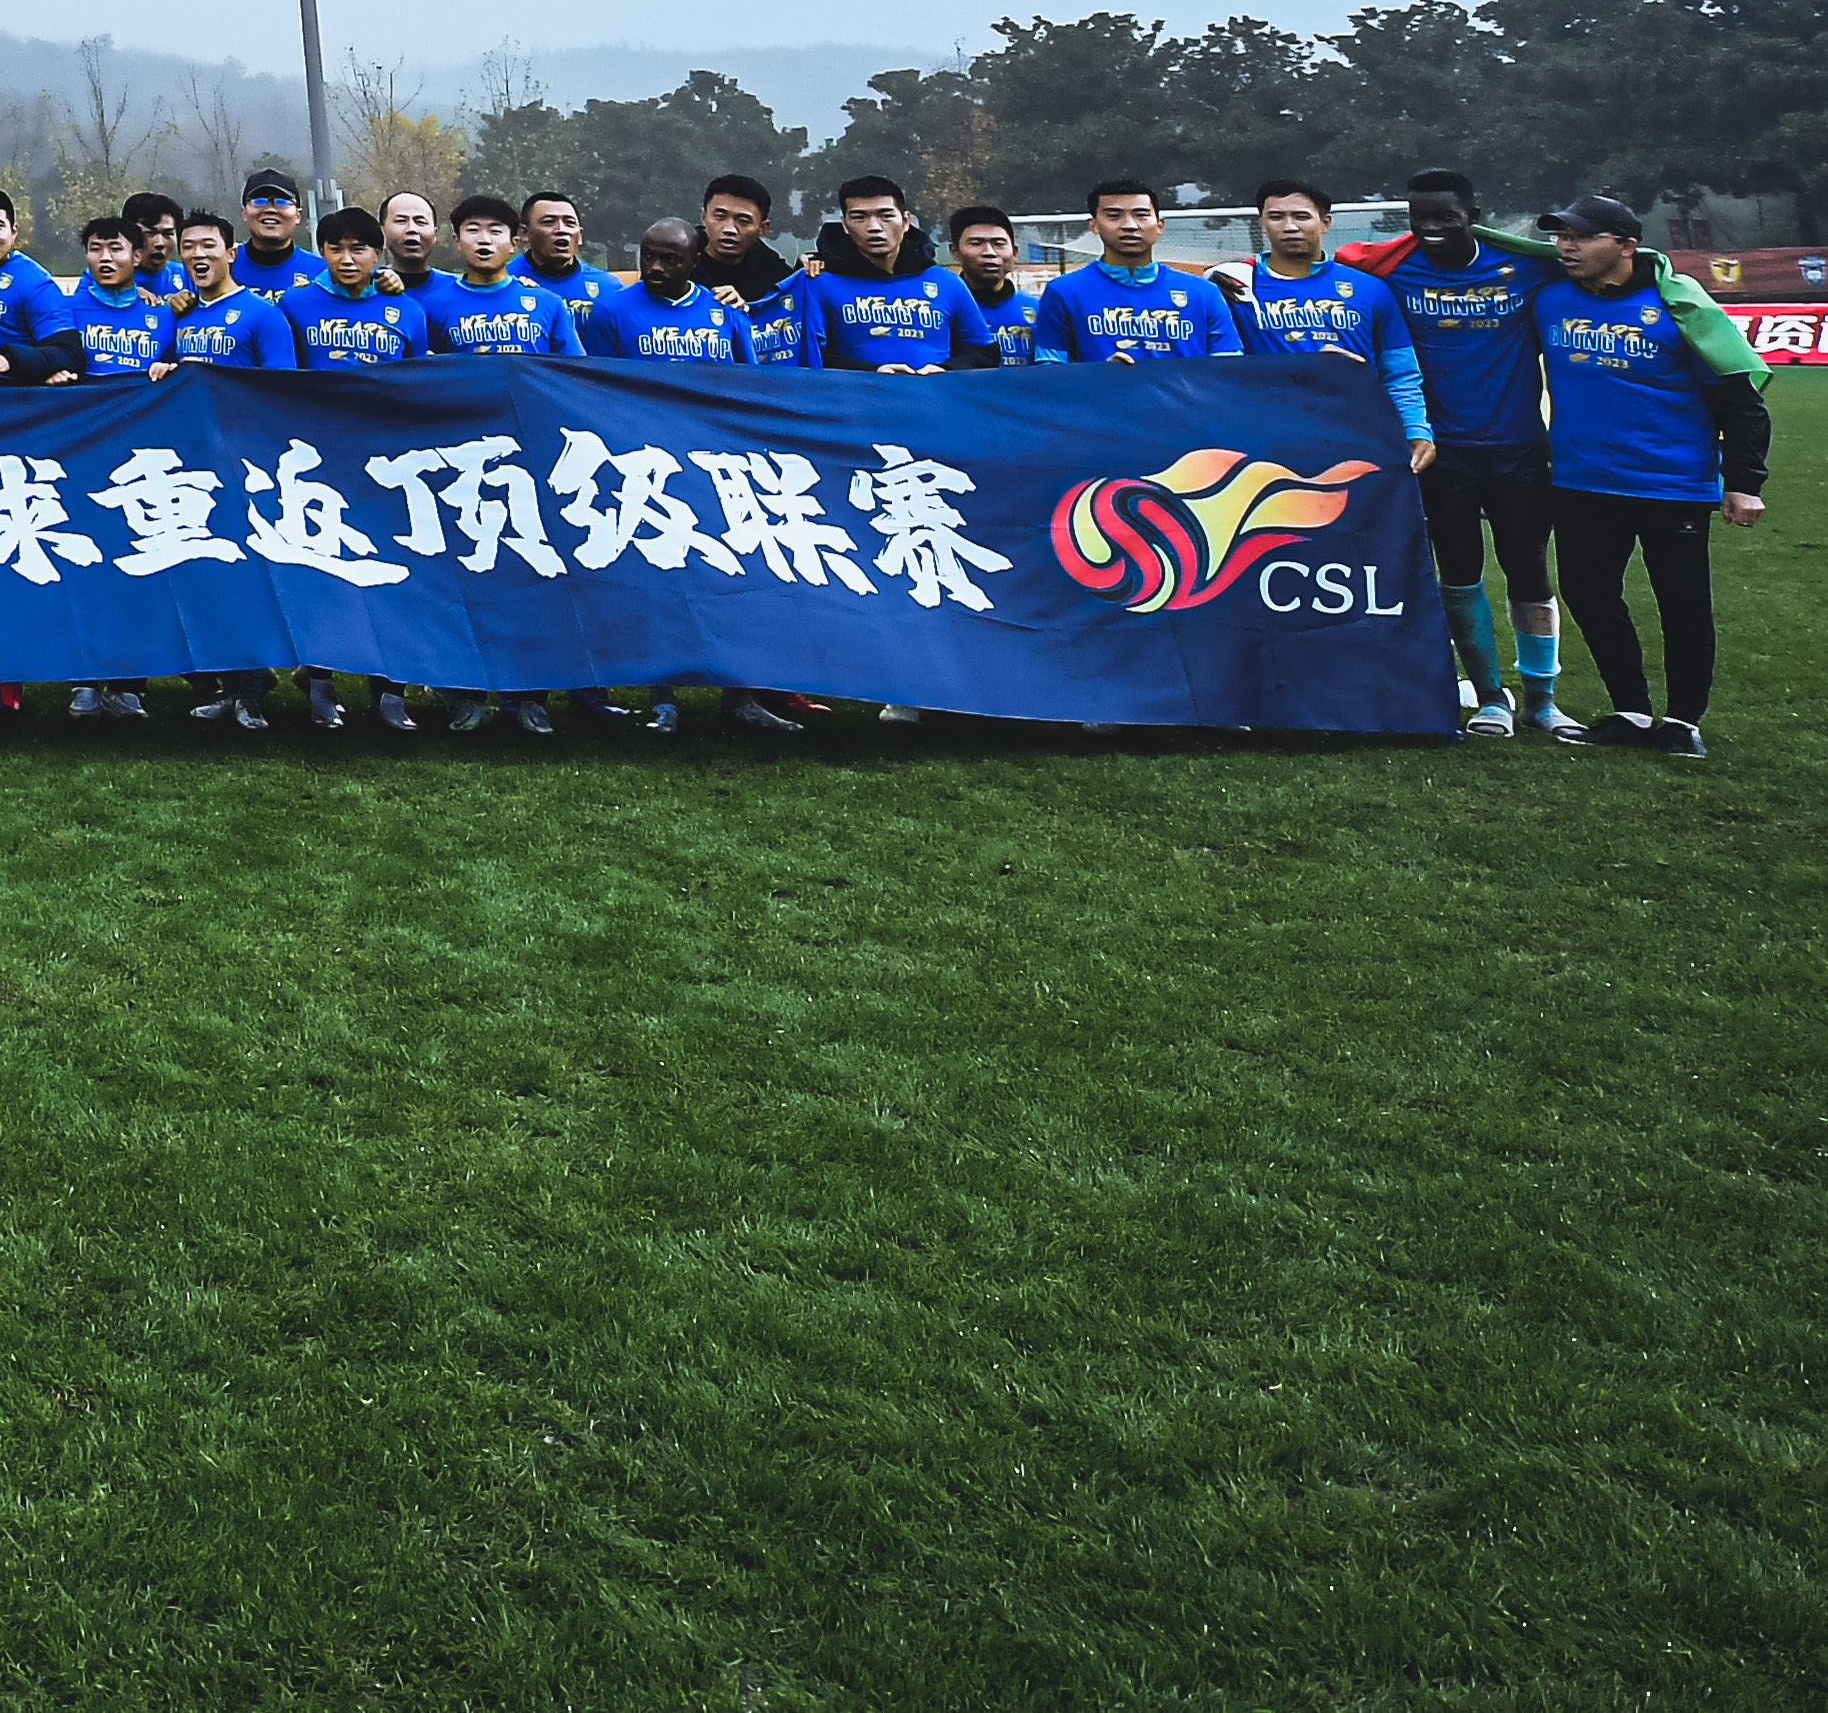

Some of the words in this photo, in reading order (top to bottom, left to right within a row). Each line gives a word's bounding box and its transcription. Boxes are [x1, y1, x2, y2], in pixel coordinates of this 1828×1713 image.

[1424, 288, 1453, 300] WE
[1465, 286, 1508, 301] ARE
[856, 296, 886, 311] WE
[893, 298, 930, 314] ARE
[1265, 298, 1297, 314] WE
[1304, 299, 1345, 314] ARE
[1406, 294, 1486, 316] GOING
[1494, 293, 1524, 316] UP
[460, 314, 488, 330] WE
[491, 313, 530, 327] ARE
[842, 304, 913, 326] GOING
[1103, 307, 1133, 322] WE
[1139, 309, 1179, 325] ARE
[1331, 309, 1361, 331] UP
[1470, 319, 1500, 328] 2023
[87, 324, 113, 338] WE
[118, 328, 152, 343] ARE
[197, 326, 226, 340] ARE
[320, 318, 348, 332] WE
[449, 321, 512, 346] GOING
[516, 323, 543, 342] UP
[897, 327, 925, 338] 2023
[1088, 315, 1159, 338] GOING
[1166, 319, 1193, 340] UP
[1562, 318, 1593, 333] WE
[1596, 323, 1643, 340] ARE
[306, 326, 369, 350] GOING
[652, 326, 680, 341] WE
[684, 328, 720, 343] ARE
[1549, 325, 1616, 353] GOING
[1624, 336, 1659, 359] UP
[211, 335, 235, 356] UP
[639, 334, 703, 357] GOING
[708, 337, 731, 359] UP
[117, 356, 141, 368] 2023
[1596, 355, 1630, 369] 2023
[1259, 561, 1404, 617] CSL
